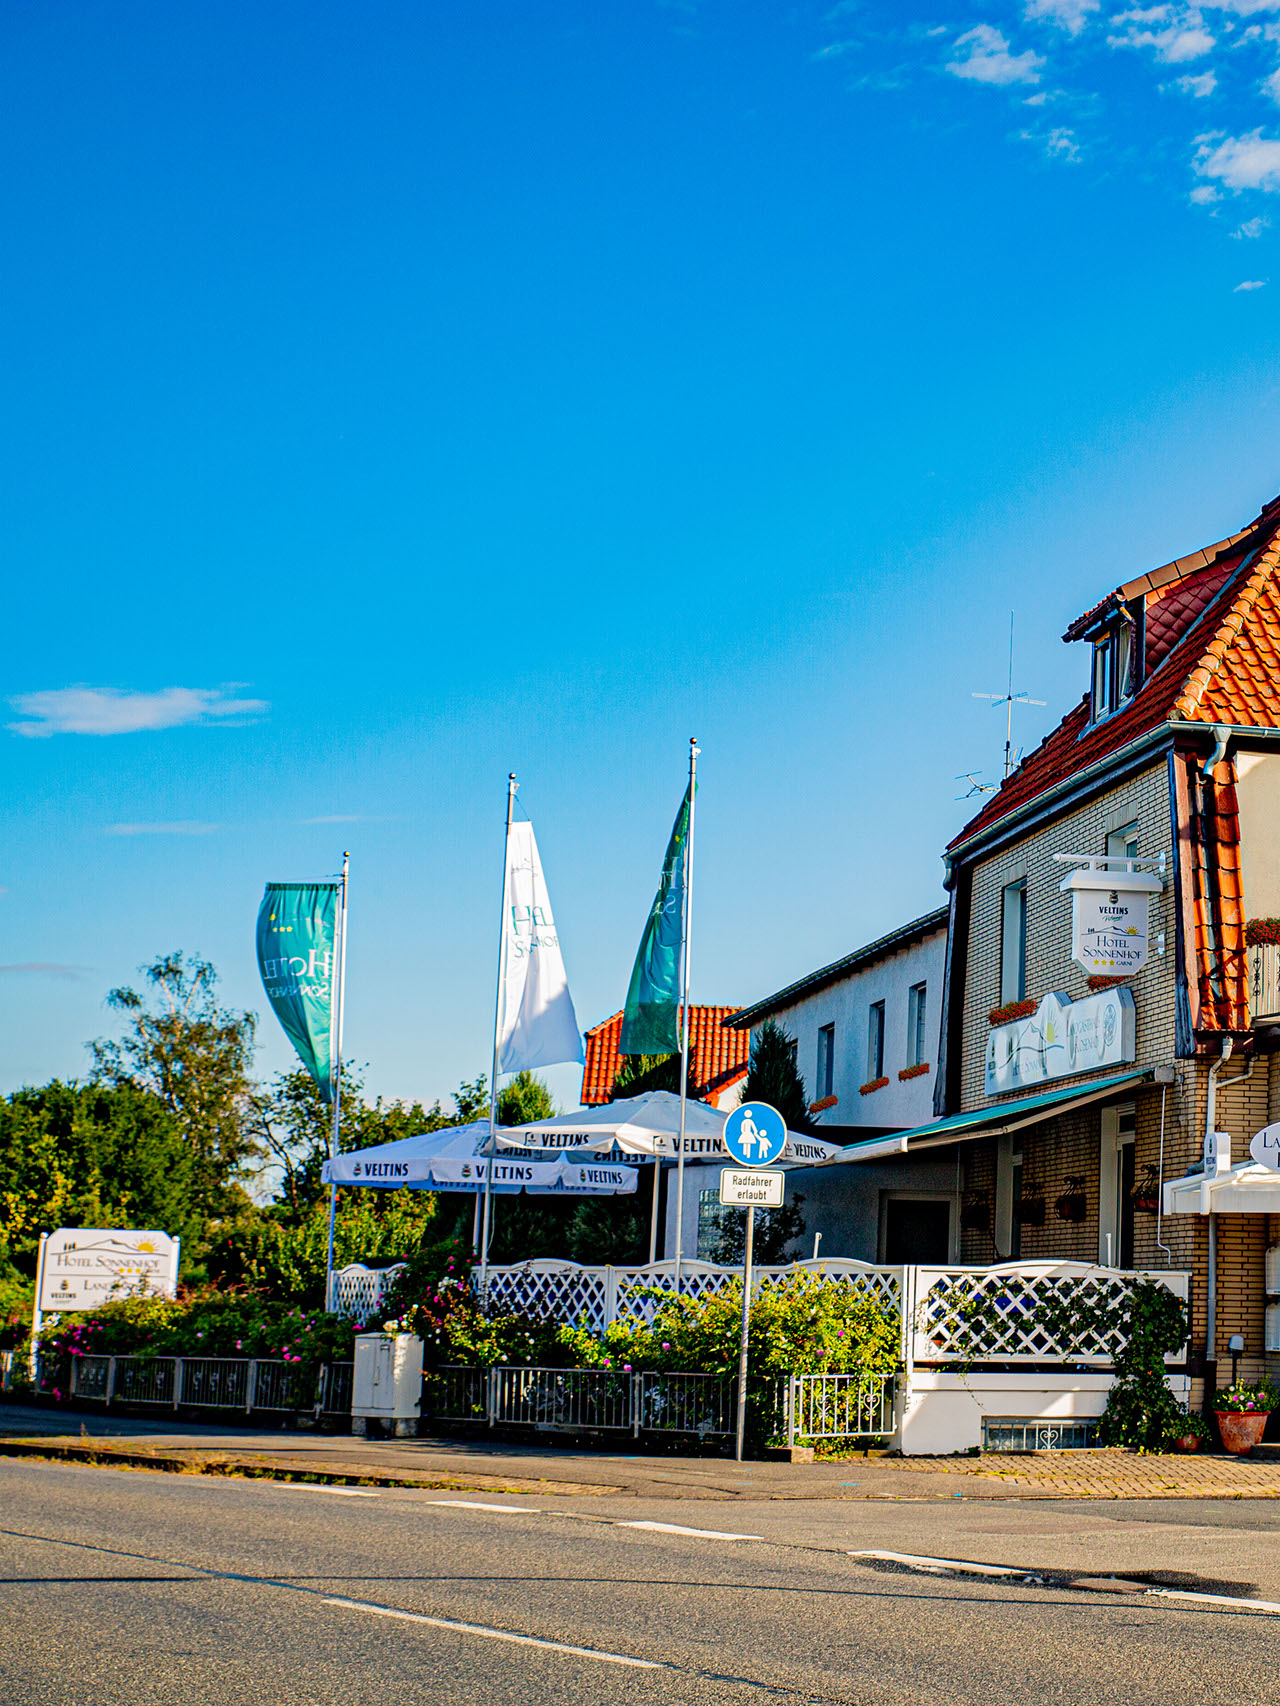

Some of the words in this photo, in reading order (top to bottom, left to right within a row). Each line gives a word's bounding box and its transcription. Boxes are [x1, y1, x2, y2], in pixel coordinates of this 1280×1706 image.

[1098, 906, 1129, 915] VELTINS
[1096, 935, 1129, 948] HOTEL
[1082, 945, 1143, 959] SONNENHOF
[541, 1133, 590, 1147] VELTINS
[672, 1138, 728, 1152] VELTIN
[793, 1143, 827, 1160] VELTINS
[364, 1163, 409, 1176] VELTINS
[475, 1165, 533, 1180] VLTINS
[587, 1169, 623, 1184] VELTINS
[732, 1174, 773, 1187] Radfahrer
[737, 1189, 767, 1200] erlaubt
[57, 1254, 93, 1267] HOTEL
[95, 1255, 160, 1269] SONNENHOF
